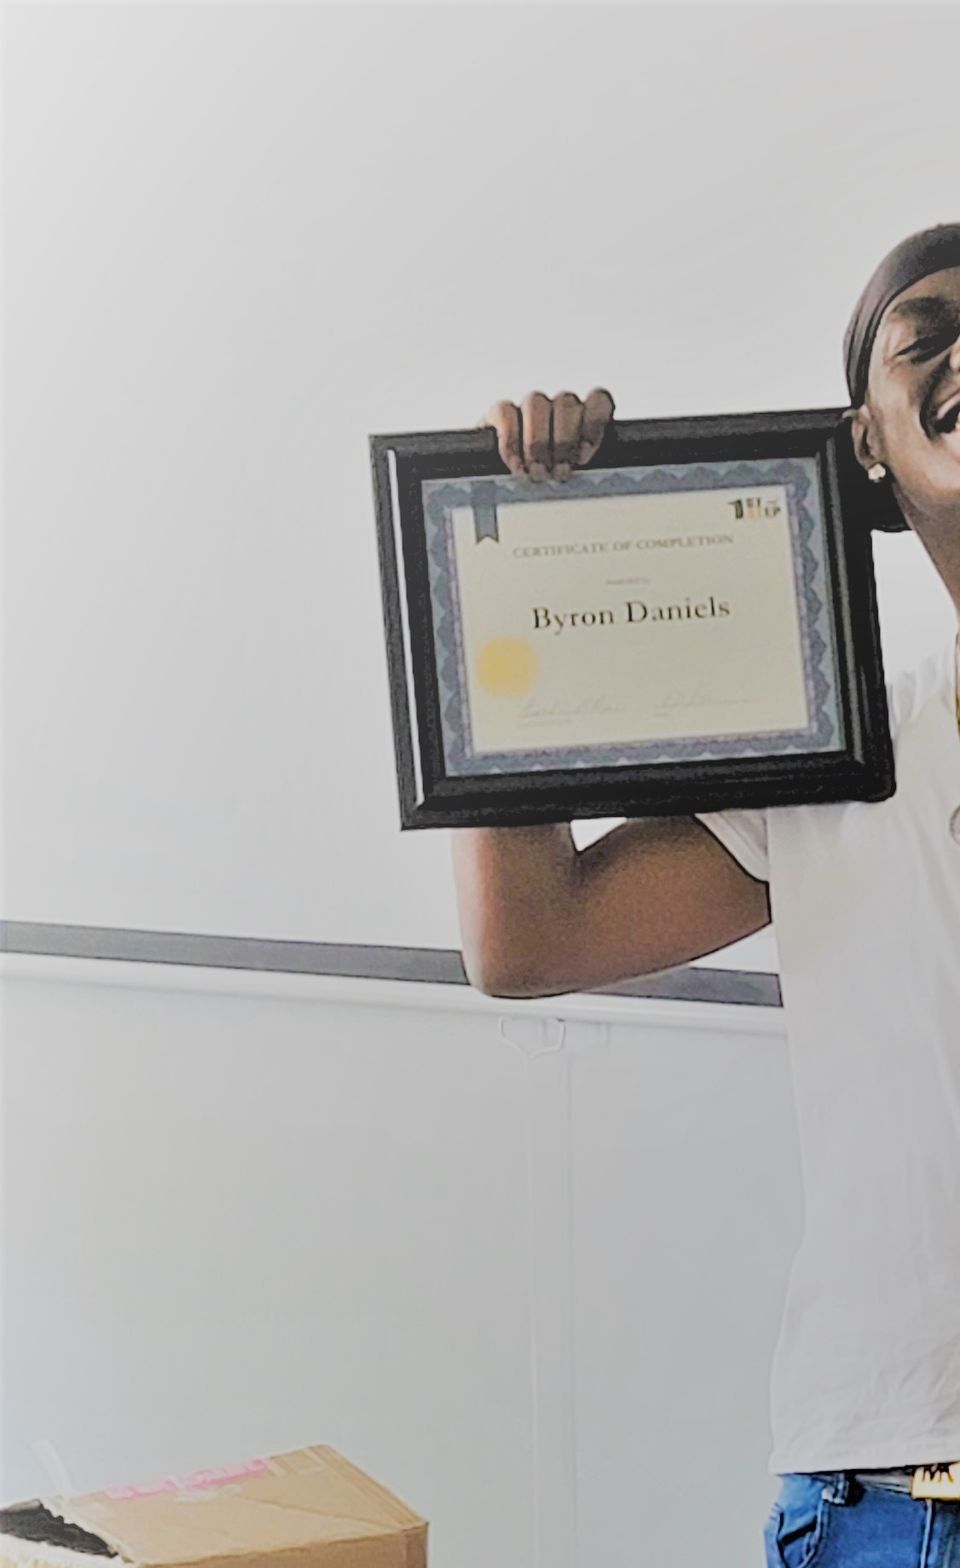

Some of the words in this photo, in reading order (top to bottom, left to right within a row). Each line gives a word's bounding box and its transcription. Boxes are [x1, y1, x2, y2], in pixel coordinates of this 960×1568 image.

[512, 540, 608, 560] CERTIFICATE
[613, 540, 632, 552] OF
[636, 533, 735, 551] COMPLETION
[532, 606, 615, 636] Byron
[625, 596, 731, 623] Daniels
